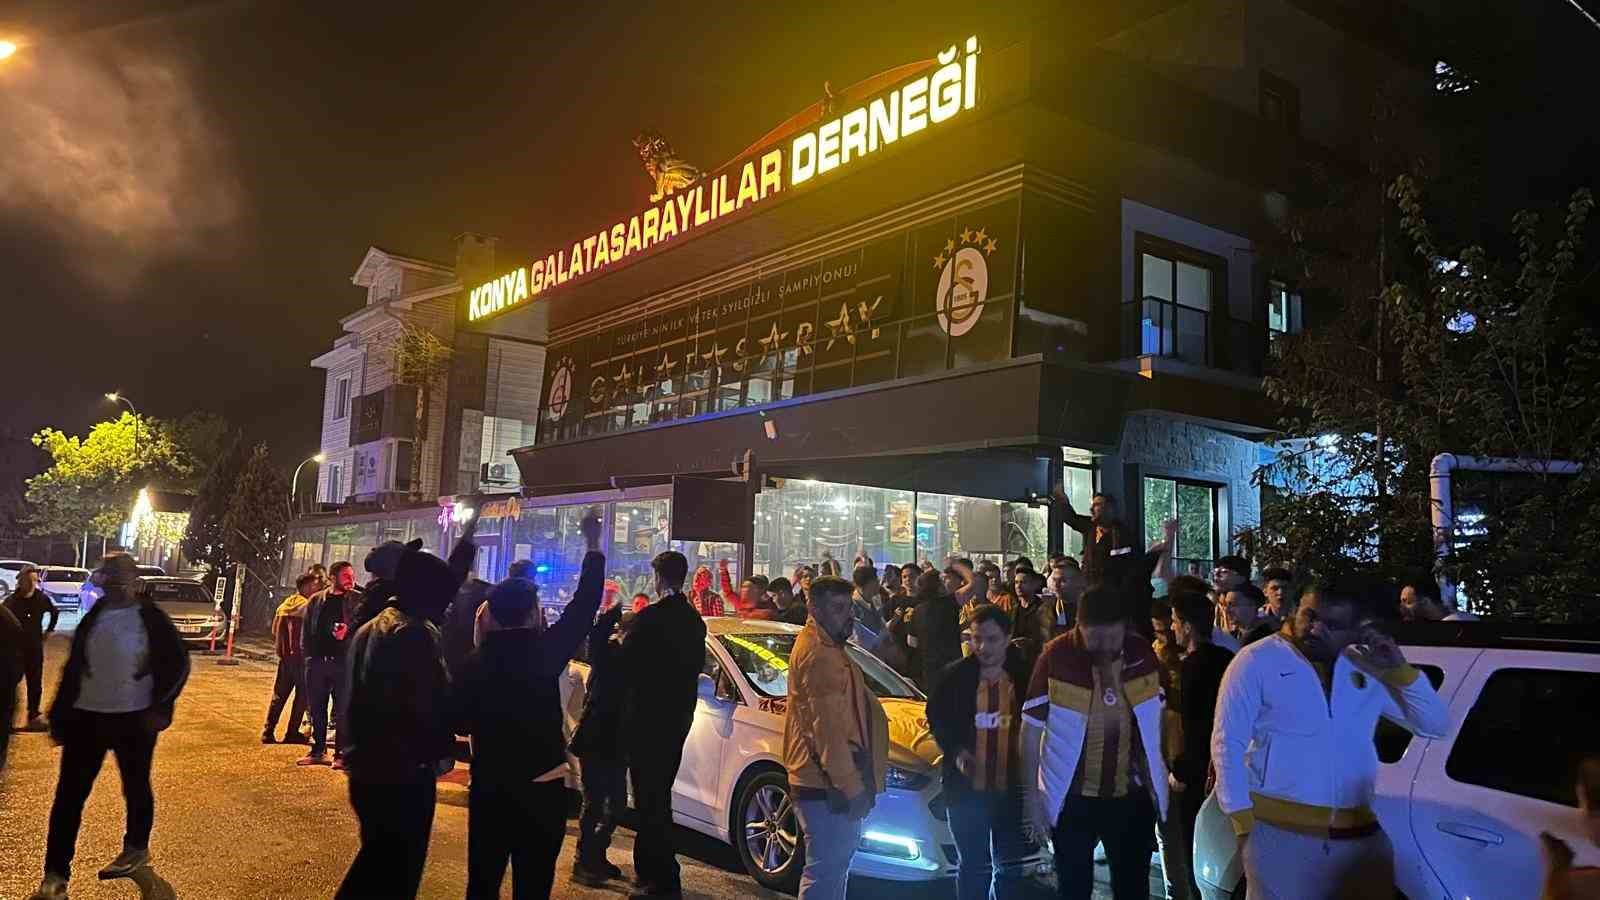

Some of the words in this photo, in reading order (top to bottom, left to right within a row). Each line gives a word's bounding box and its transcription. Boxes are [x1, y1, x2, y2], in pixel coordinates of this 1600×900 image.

[469, 267, 528, 321] KONYA
[530, 149, 783, 296] GALATASARAYLILAR
[791, 34, 978, 186] DERNEĞİ
